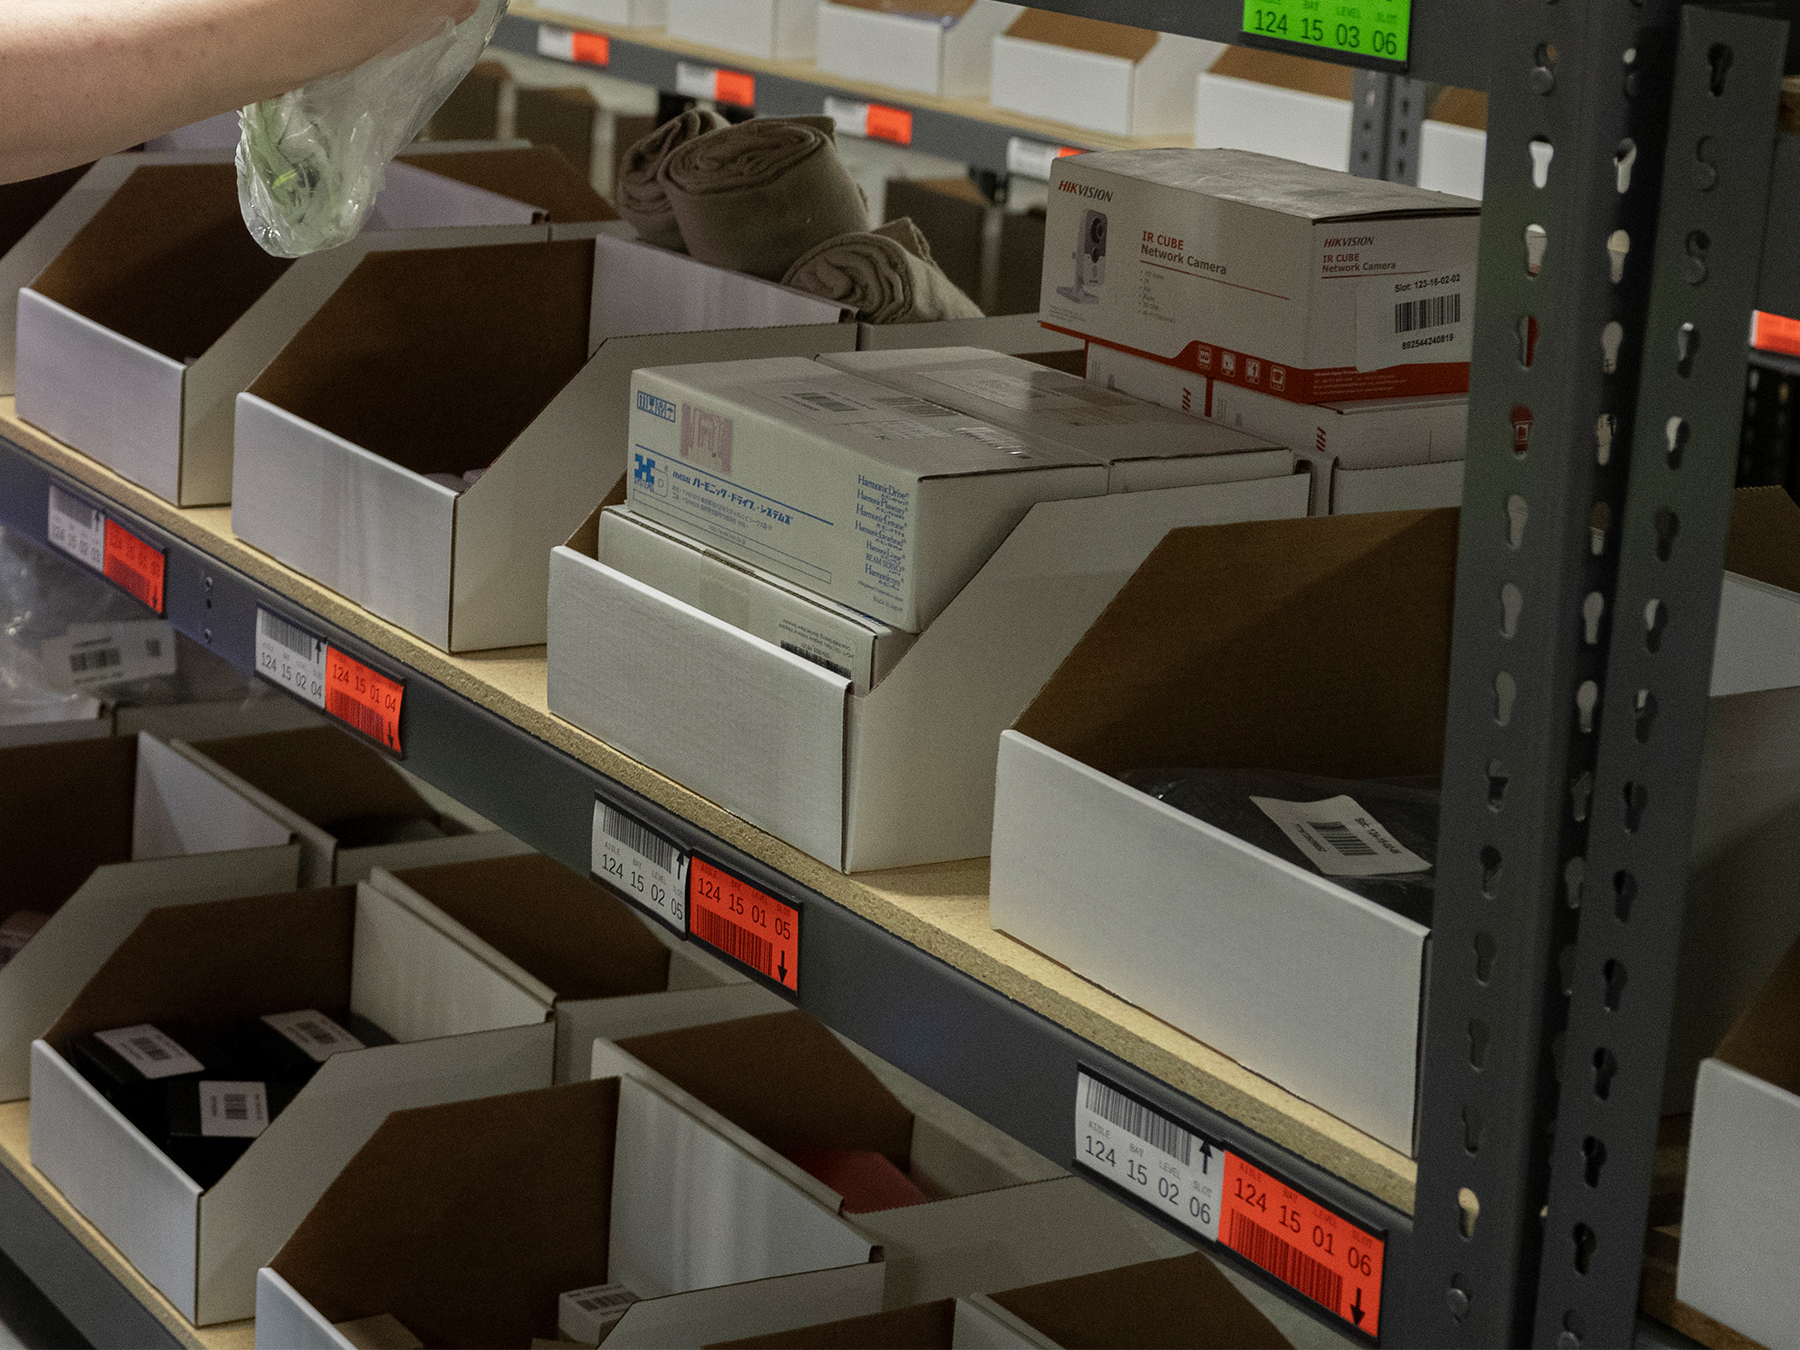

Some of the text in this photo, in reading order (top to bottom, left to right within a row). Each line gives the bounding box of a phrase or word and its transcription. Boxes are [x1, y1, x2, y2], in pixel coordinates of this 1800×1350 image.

[1255, 9, 1397, 55] 124 15 03 06
[1058, 180, 1114, 202] HIKVISION
[1141, 244, 1227, 275] Network Camera
[1142, 231, 1184, 250] IR CUBE
[1322, 253, 1359, 263] IR CUBE
[1323, 236, 1375, 248] HIKVISION
[1322, 262, 1396, 273] Network Camera
[261, 652, 276, 671] 124
[281, 663, 291, 681] 15
[296, 672, 306, 690] 02
[311, 681, 322, 698] 04
[333, 664, 349, 684] 124
[355, 676, 365, 694] 15
[370, 684, 380, 703] 01
[385, 694, 396, 712] 04
[602, 853, 683, 921] 124 15 02 05
[651, 870, 667, 885] LEVEL
[698, 877, 791, 940] 124 15 01 05
[1088, 1120, 1111, 1139] AISLE
[1129, 1143, 1144, 1157] BAY
[1159, 1160, 1181, 1180] LEVEL
[1085, 1135, 1210, 1224] 124 15 02 06
[1234, 1177, 1371, 1277] 124 15 01 06
